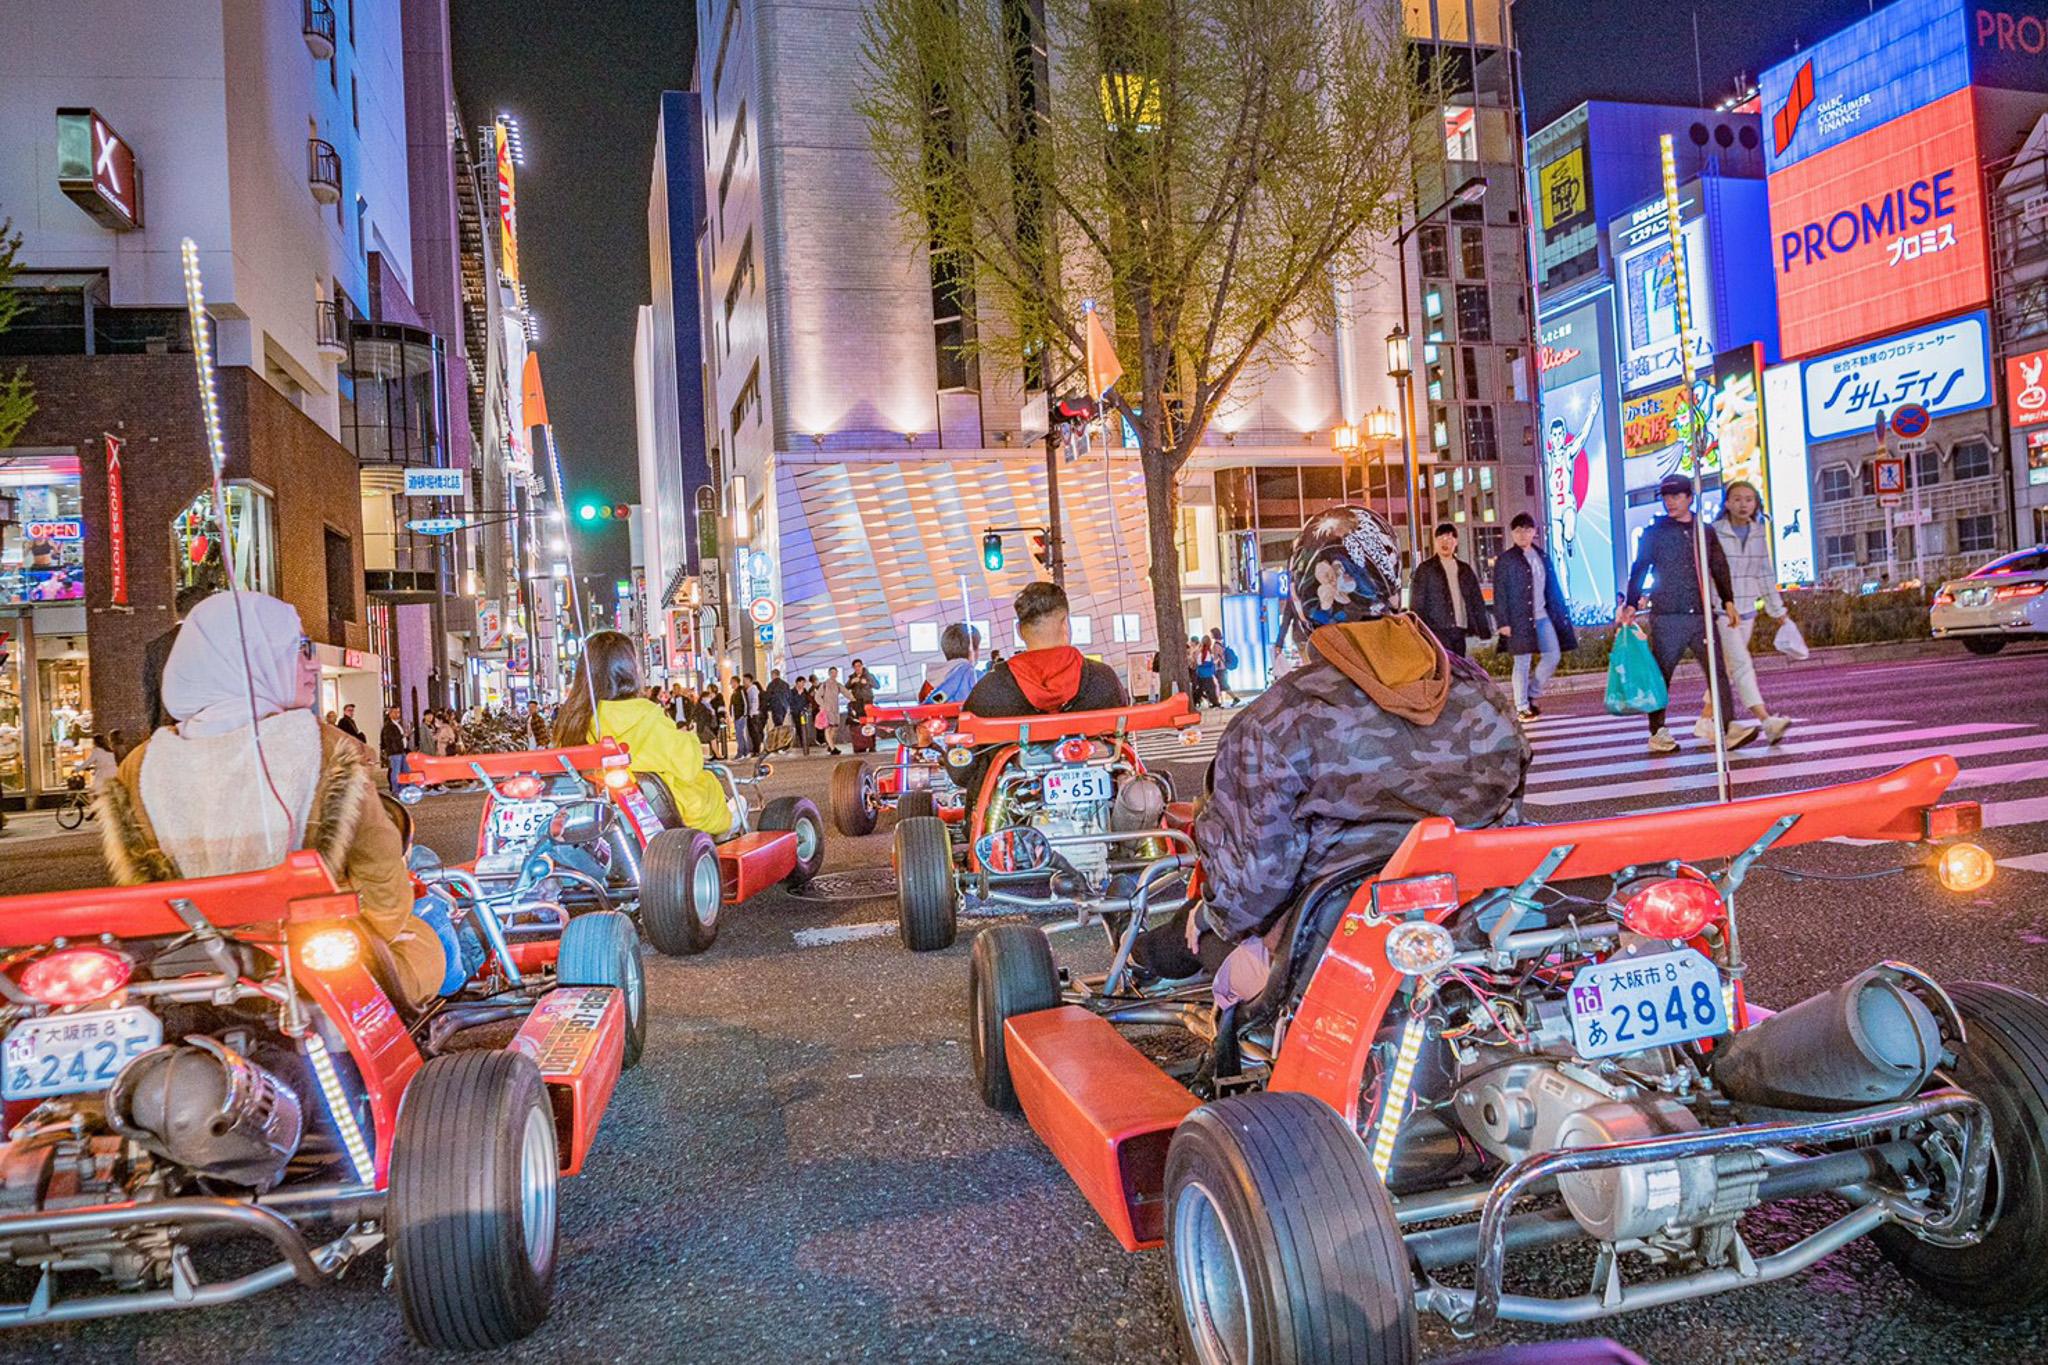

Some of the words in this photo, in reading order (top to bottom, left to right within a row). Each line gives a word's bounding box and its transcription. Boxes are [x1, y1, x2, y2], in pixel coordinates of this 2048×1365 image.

[1976, 9, 2048, 54] PRO
[1817, 94, 1844, 114] SMBC
[1817, 93, 1872, 125] CONSUMER
[1818, 110, 1861, 136] FINANCE
[1781, 168, 1955, 273] PROMISE
[1886, 222, 1957, 268] プロミス
[1541, 346, 1581, 372] lico
[1832, 333, 1957, 374] 総合不動産のプロデューサー
[1845, 369, 1938, 414] サムティ
[1553, 466, 1566, 506] グリコ
[110, 474, 120, 533] CROSS
[29, 523, 78, 538] OPEN
[112, 539, 122, 602] HOTEL
[1609, 966, 1661, 992] 大阪市
[1664, 962, 1678, 982] 8
[1577, 995, 1600, 1014] 10
[1610, 980, 1716, 1042] 2948
[45, 1022, 99, 1044] 大阪市
[103, 1019, 117, 1037] 8
[1587, 1018, 1608, 1048] あ
[12, 1066, 33, 1091] あ
